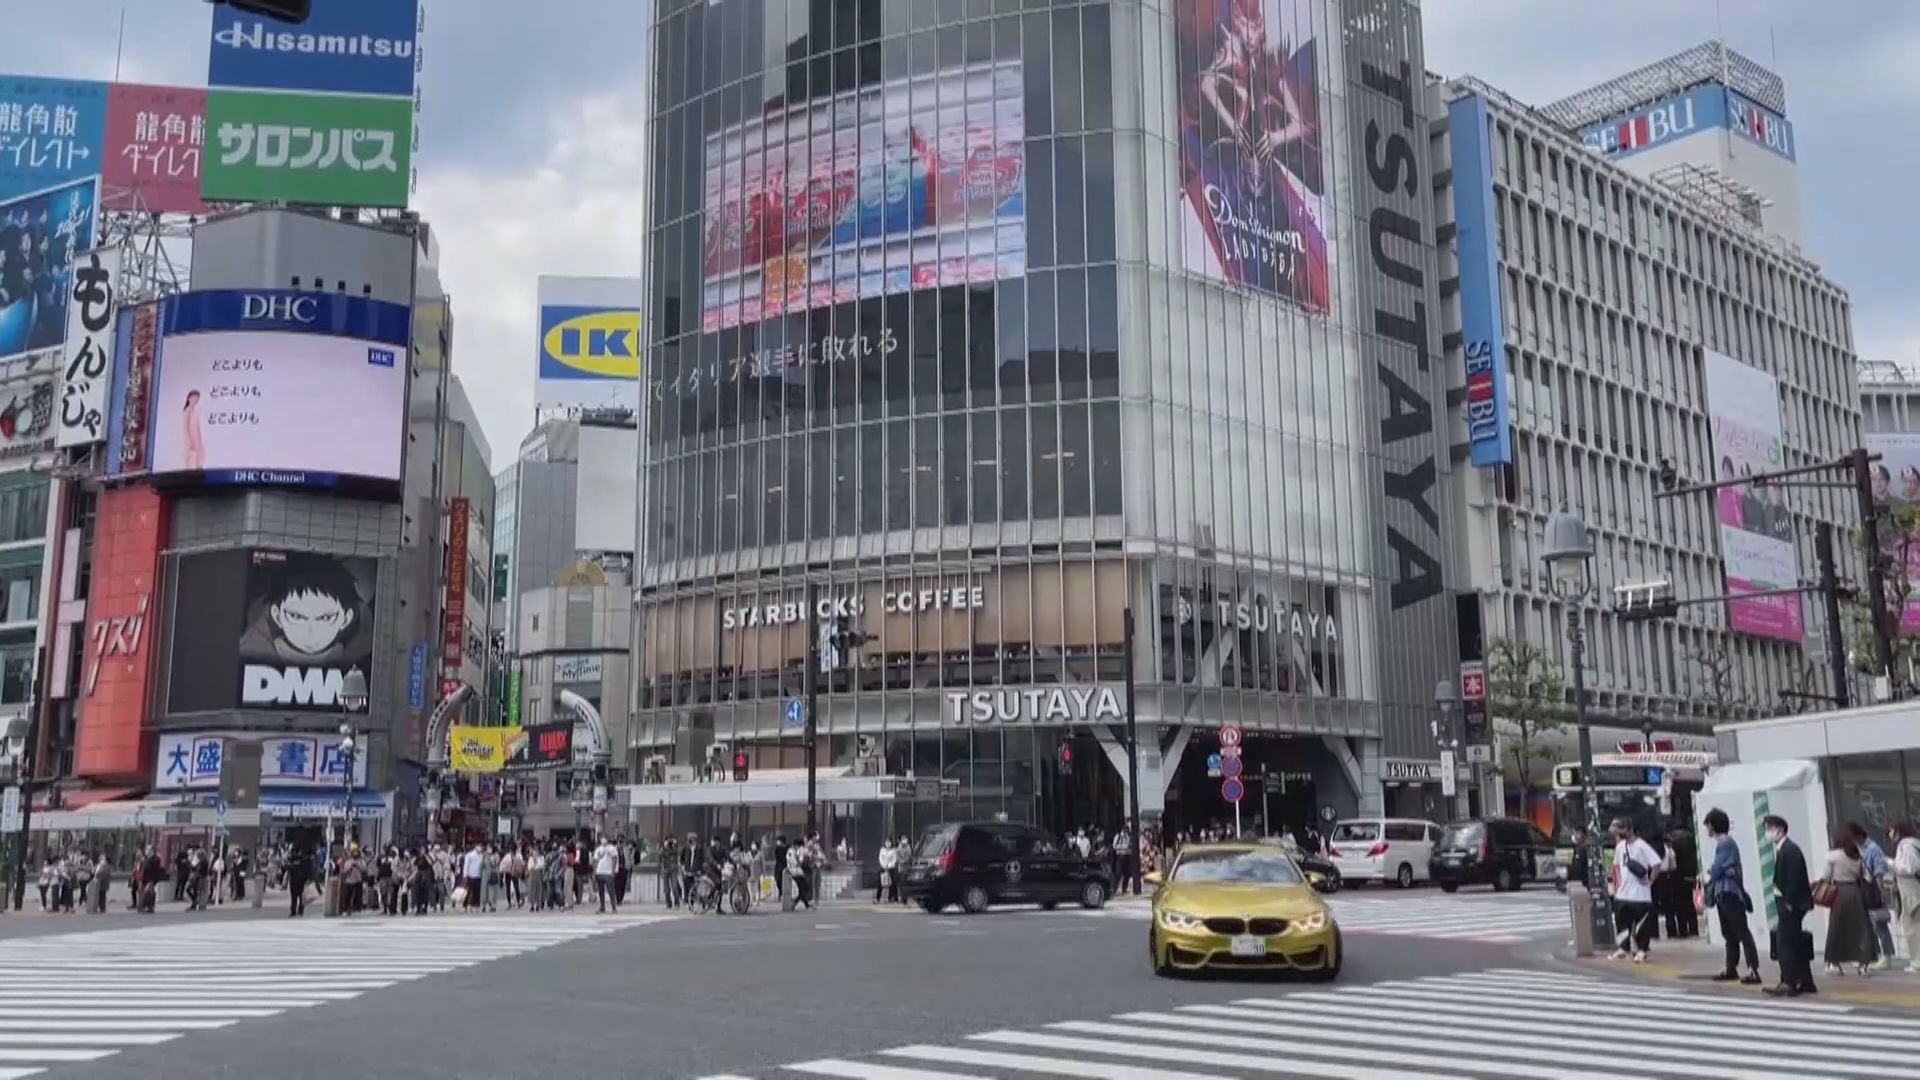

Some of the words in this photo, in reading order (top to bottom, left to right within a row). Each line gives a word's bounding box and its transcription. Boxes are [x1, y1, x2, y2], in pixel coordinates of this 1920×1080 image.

[215, 22, 412, 58] Hisamitsu
[0, 102, 79, 137] 龍角散
[1730, 103, 1790, 152] SEIBU
[217, 122, 397, 173] サロンパス
[242, 293, 318, 323] DHC
[61, 253, 112, 437] もんじゃ
[561, 327, 640, 358] IK
[1361, 60, 1443, 611] TSUTAYA
[211, 358, 264, 372] どこよりも
[209, 384, 262, 399] どこよりも
[1465, 340, 1498, 445] SEIBU
[207, 411, 260, 425] どこよりも
[233, 470, 259, 483] DHC
[260, 471, 305, 483] Channel
[723, 592, 865, 630] STARBCKS
[881, 585, 984, 614] COFFEE
[1218, 600, 1338, 642] TSUTAYA
[84, 591, 148, 697] クスリ
[946, 687, 1122, 728] TSUTAYA
[1386, 762, 1432, 778] TSUTAYA
